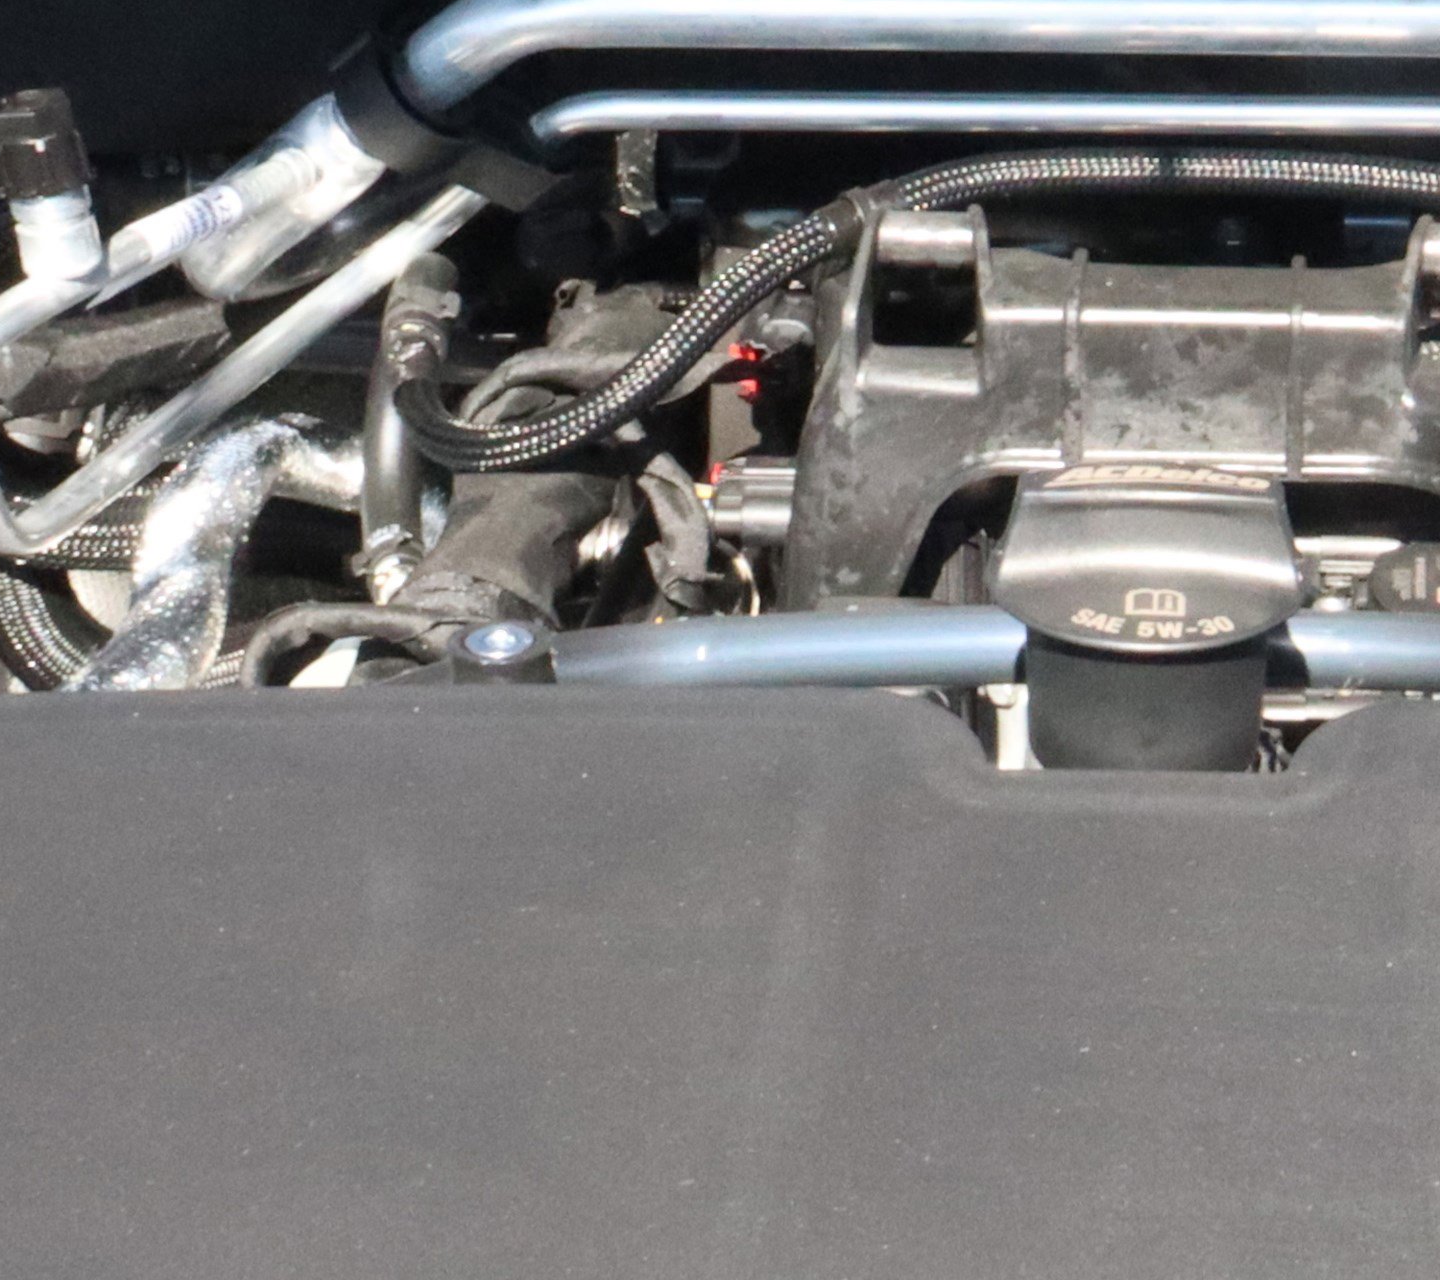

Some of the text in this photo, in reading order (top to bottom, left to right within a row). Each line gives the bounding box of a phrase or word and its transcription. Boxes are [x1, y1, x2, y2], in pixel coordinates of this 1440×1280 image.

[1046, 465, 1271, 490] ACDelco
[1070, 607, 1236, 639] SAE 5W-30
